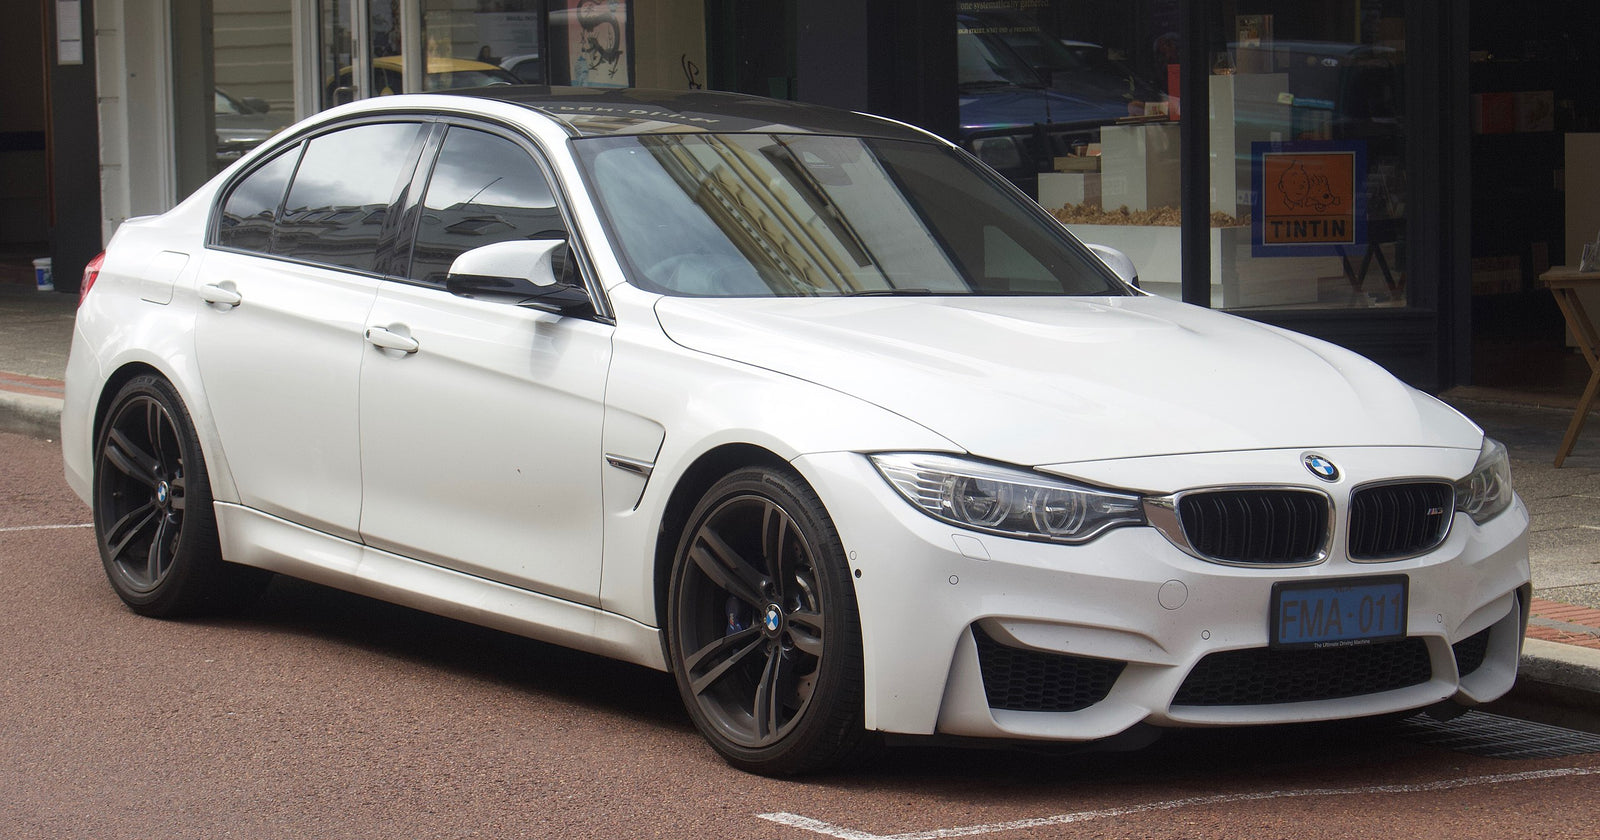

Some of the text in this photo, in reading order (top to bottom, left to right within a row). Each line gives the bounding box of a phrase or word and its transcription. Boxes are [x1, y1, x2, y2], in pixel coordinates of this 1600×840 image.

[960, 2, 972, 10] one
[973, 0, 1018, 12] systematically
[1270, 220, 1346, 238] TINTIN
[1340, 639, 1353, 647] Driving
